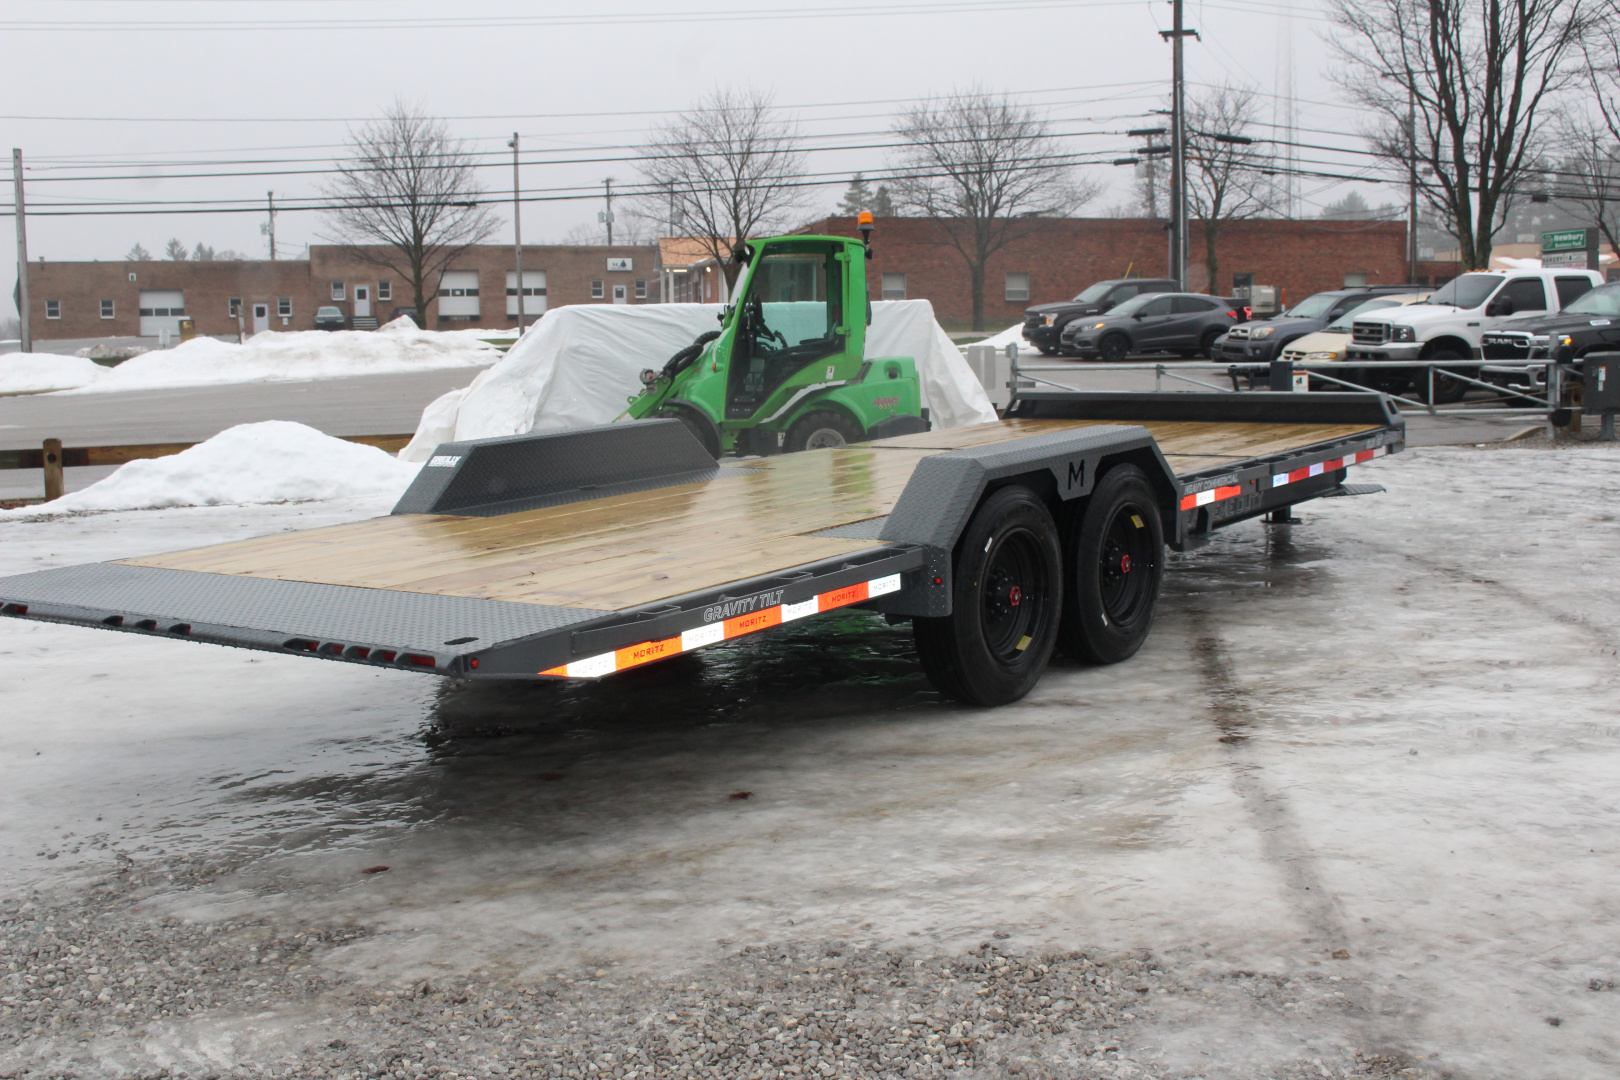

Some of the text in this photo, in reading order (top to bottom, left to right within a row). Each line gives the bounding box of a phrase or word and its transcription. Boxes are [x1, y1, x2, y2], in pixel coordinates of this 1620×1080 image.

[1068, 459, 1085, 490] M
[1184, 481, 1204, 495] HEAVY
[1204, 473, 1239, 489] COMMERCIAL
[873, 579, 896, 591] MORITZ
[831, 590, 856, 604] MORITZ
[703, 589, 784, 623] GRAVITY TILT
[787, 602, 813, 614] MORITZ
[739, 615, 767, 629] MORITZ
[688, 629, 717, 642] MORITZ
[633, 644, 665, 660] MORITZ
[574, 660, 608, 675] MORITZ
